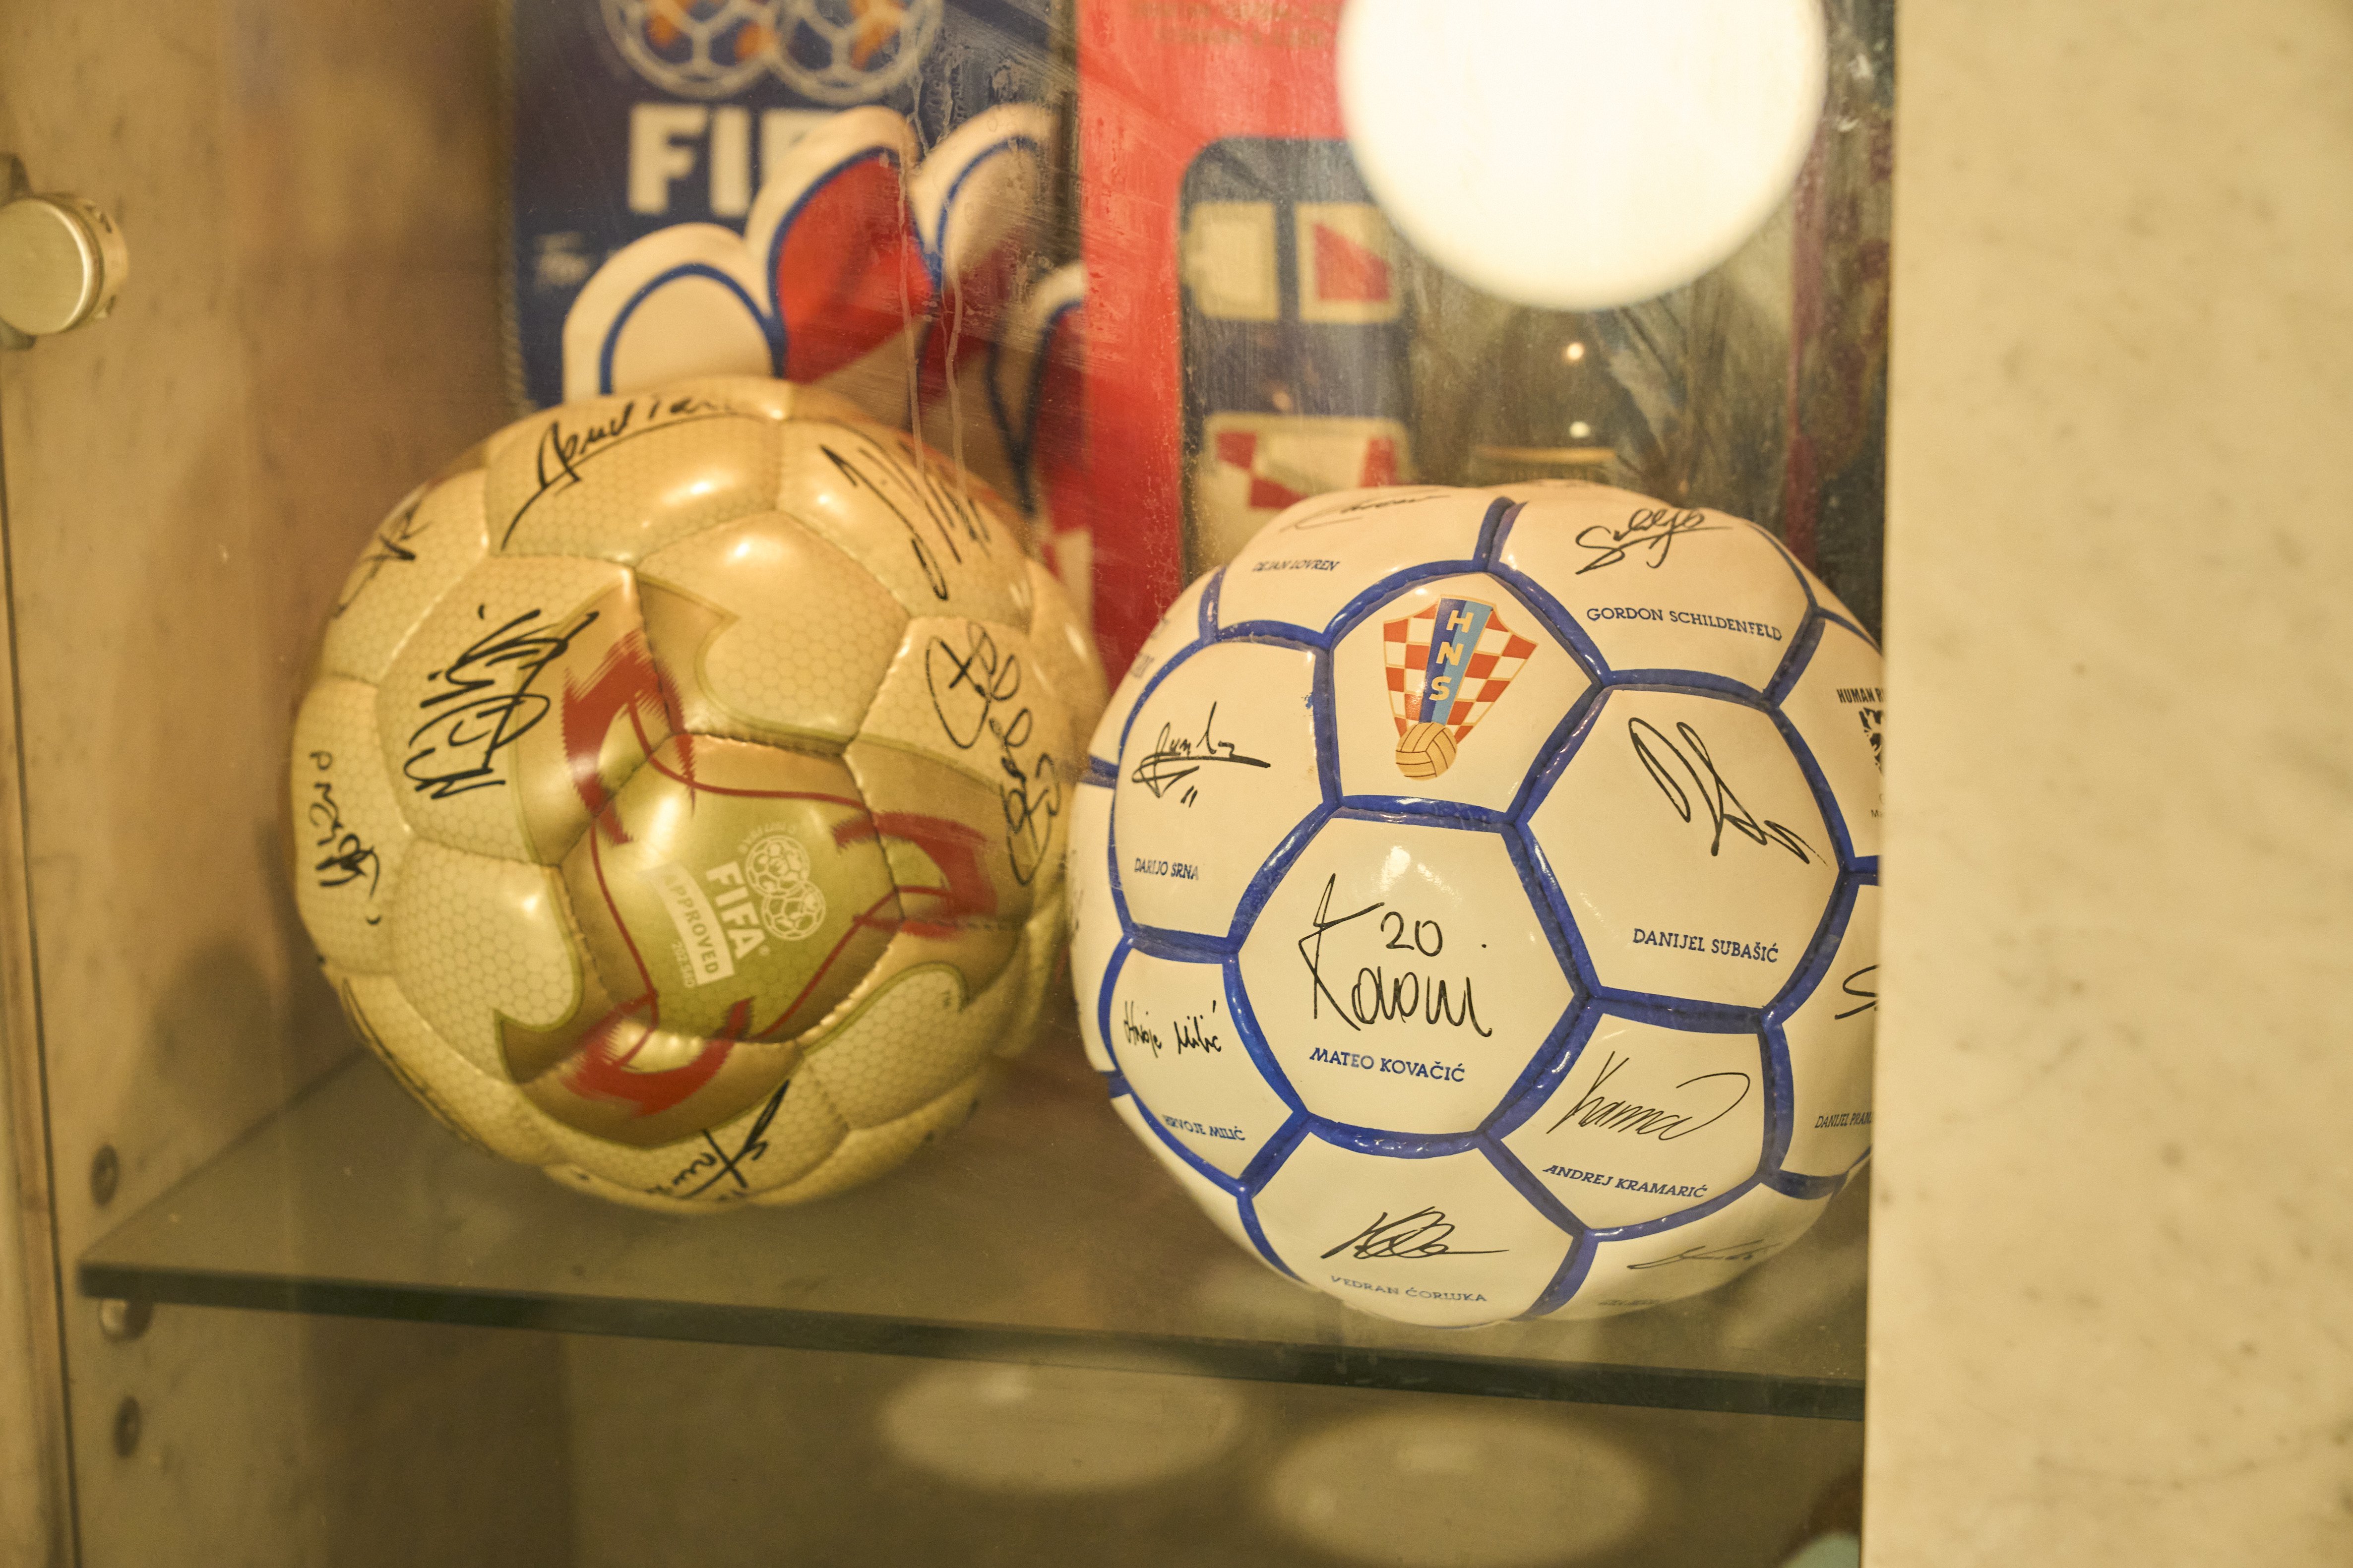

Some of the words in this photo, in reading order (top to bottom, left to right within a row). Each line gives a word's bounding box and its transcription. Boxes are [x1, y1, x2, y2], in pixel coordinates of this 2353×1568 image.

[1586, 607, 1663, 622] GORDON
[1669, 611, 1782, 641] SCHILDENFELD
[1428, 609, 1473, 702] HNS
[1837, 688, 1875, 703] HUMAN
[1171, 862, 1199, 880] SRNA
[663, 873, 719, 973] APPROVED
[706, 861, 766, 960] FIFA
[1380, 911, 1443, 957] 20
[1633, 928, 1705, 951] DANIJEL
[1711, 939, 1779, 963] SUBAŠIĆ
[1309, 1047, 1374, 1070] MATEO
[1380, 1059, 1466, 1082] KOVAČIĆ
[1814, 1113, 1850, 1128] DANIJEL
[1543, 1165, 1613, 1186] ANDREJ
[1615, 1179, 1708, 1198] KRAMARIĆ
[1331, 1275, 1399, 1295] VEDRAN
